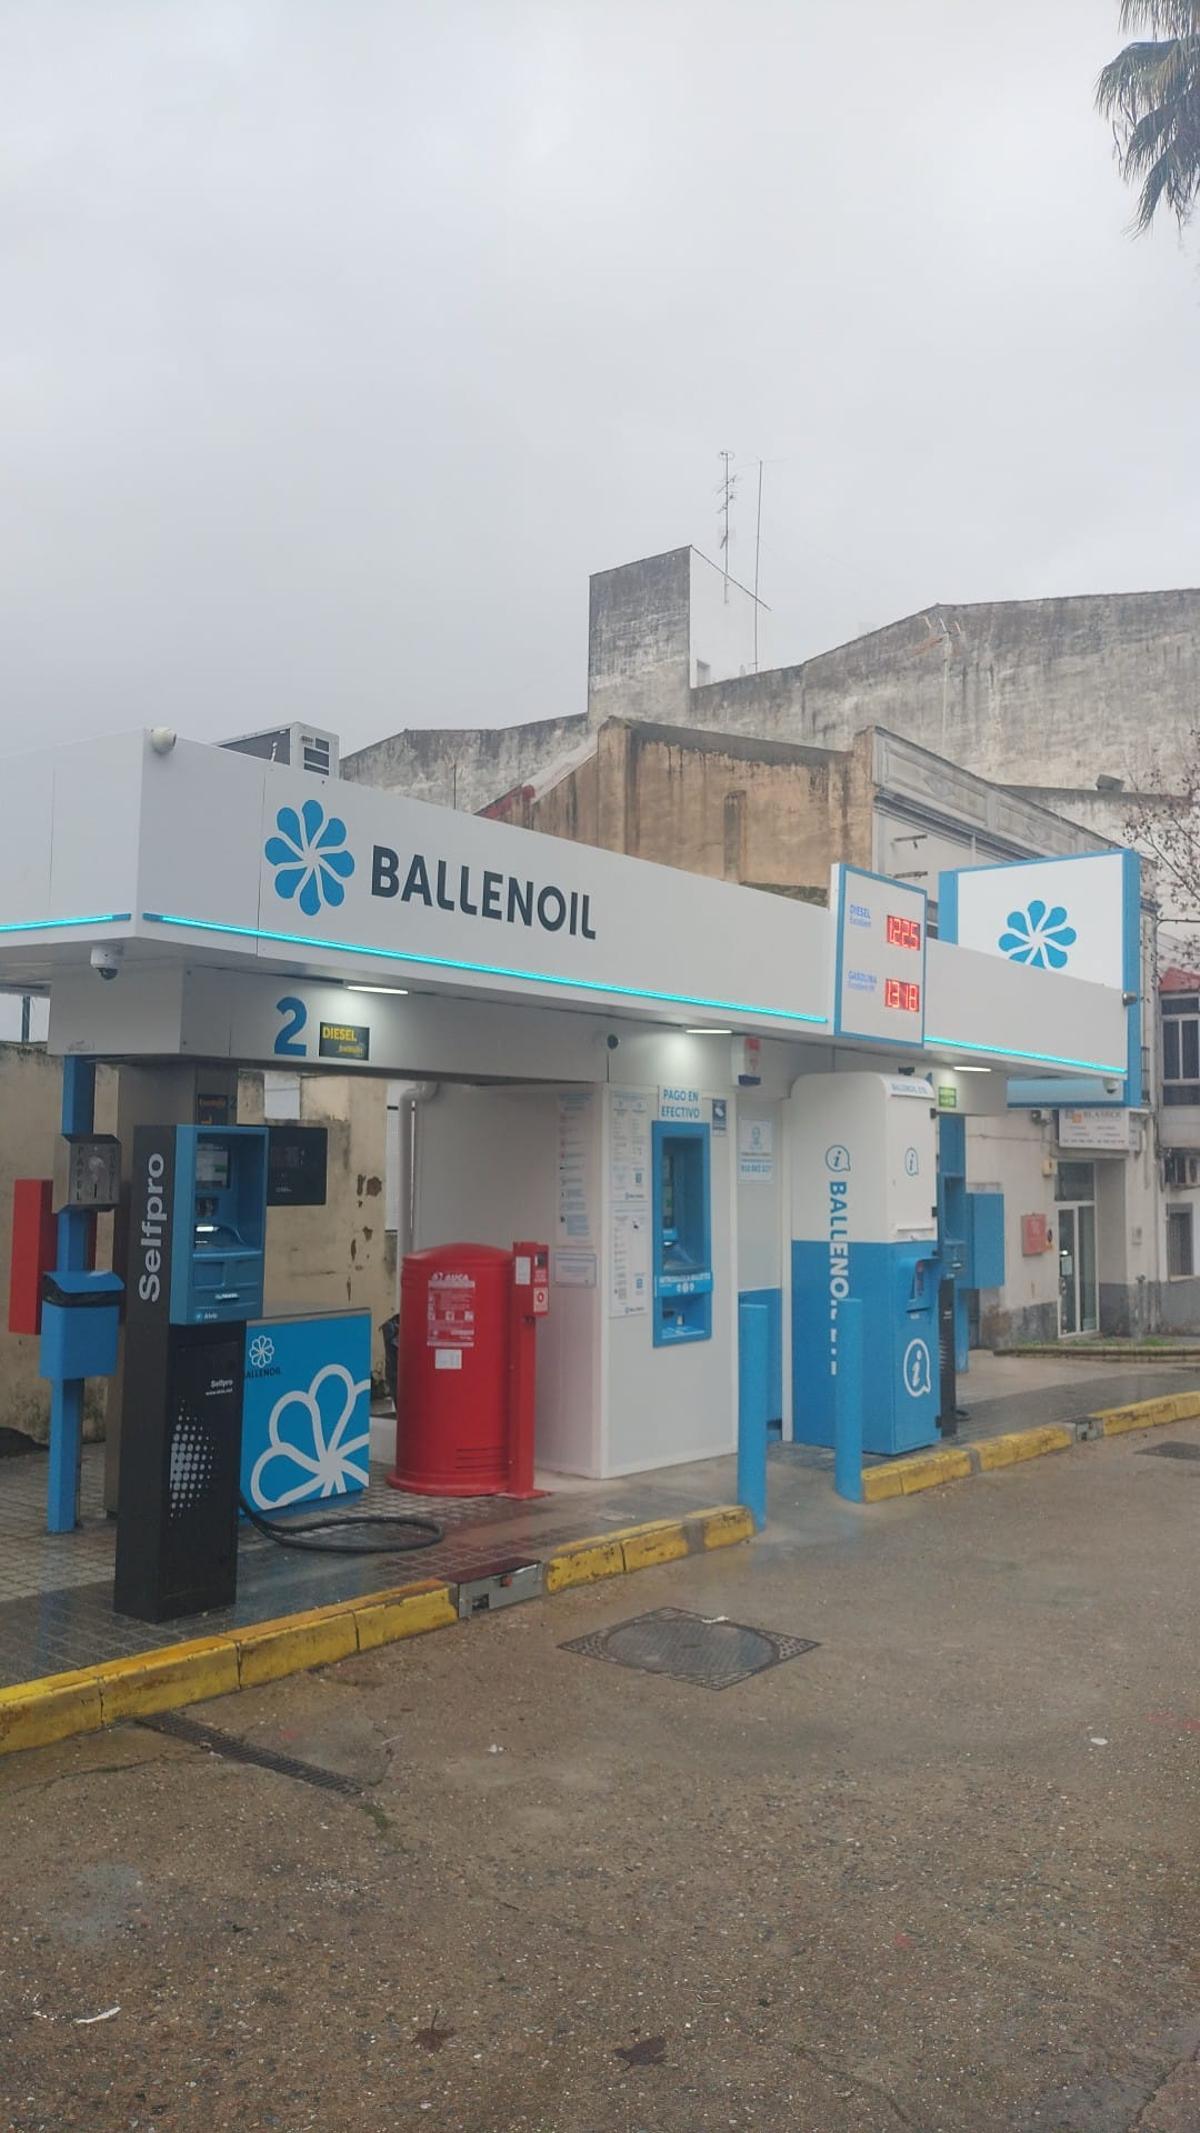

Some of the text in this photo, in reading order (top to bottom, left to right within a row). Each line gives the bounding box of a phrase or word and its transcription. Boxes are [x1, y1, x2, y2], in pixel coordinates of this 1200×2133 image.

[371, 844, 597, 940] BALLENOIL
[274, 996, 307, 1057] 2
[322, 1025, 357, 1042] DIESEL
[661, 1106, 700, 1119] EFECTIVO
[663, 1089, 699, 1102] PAGO EN
[138, 1152, 167, 1302] Selfpro
